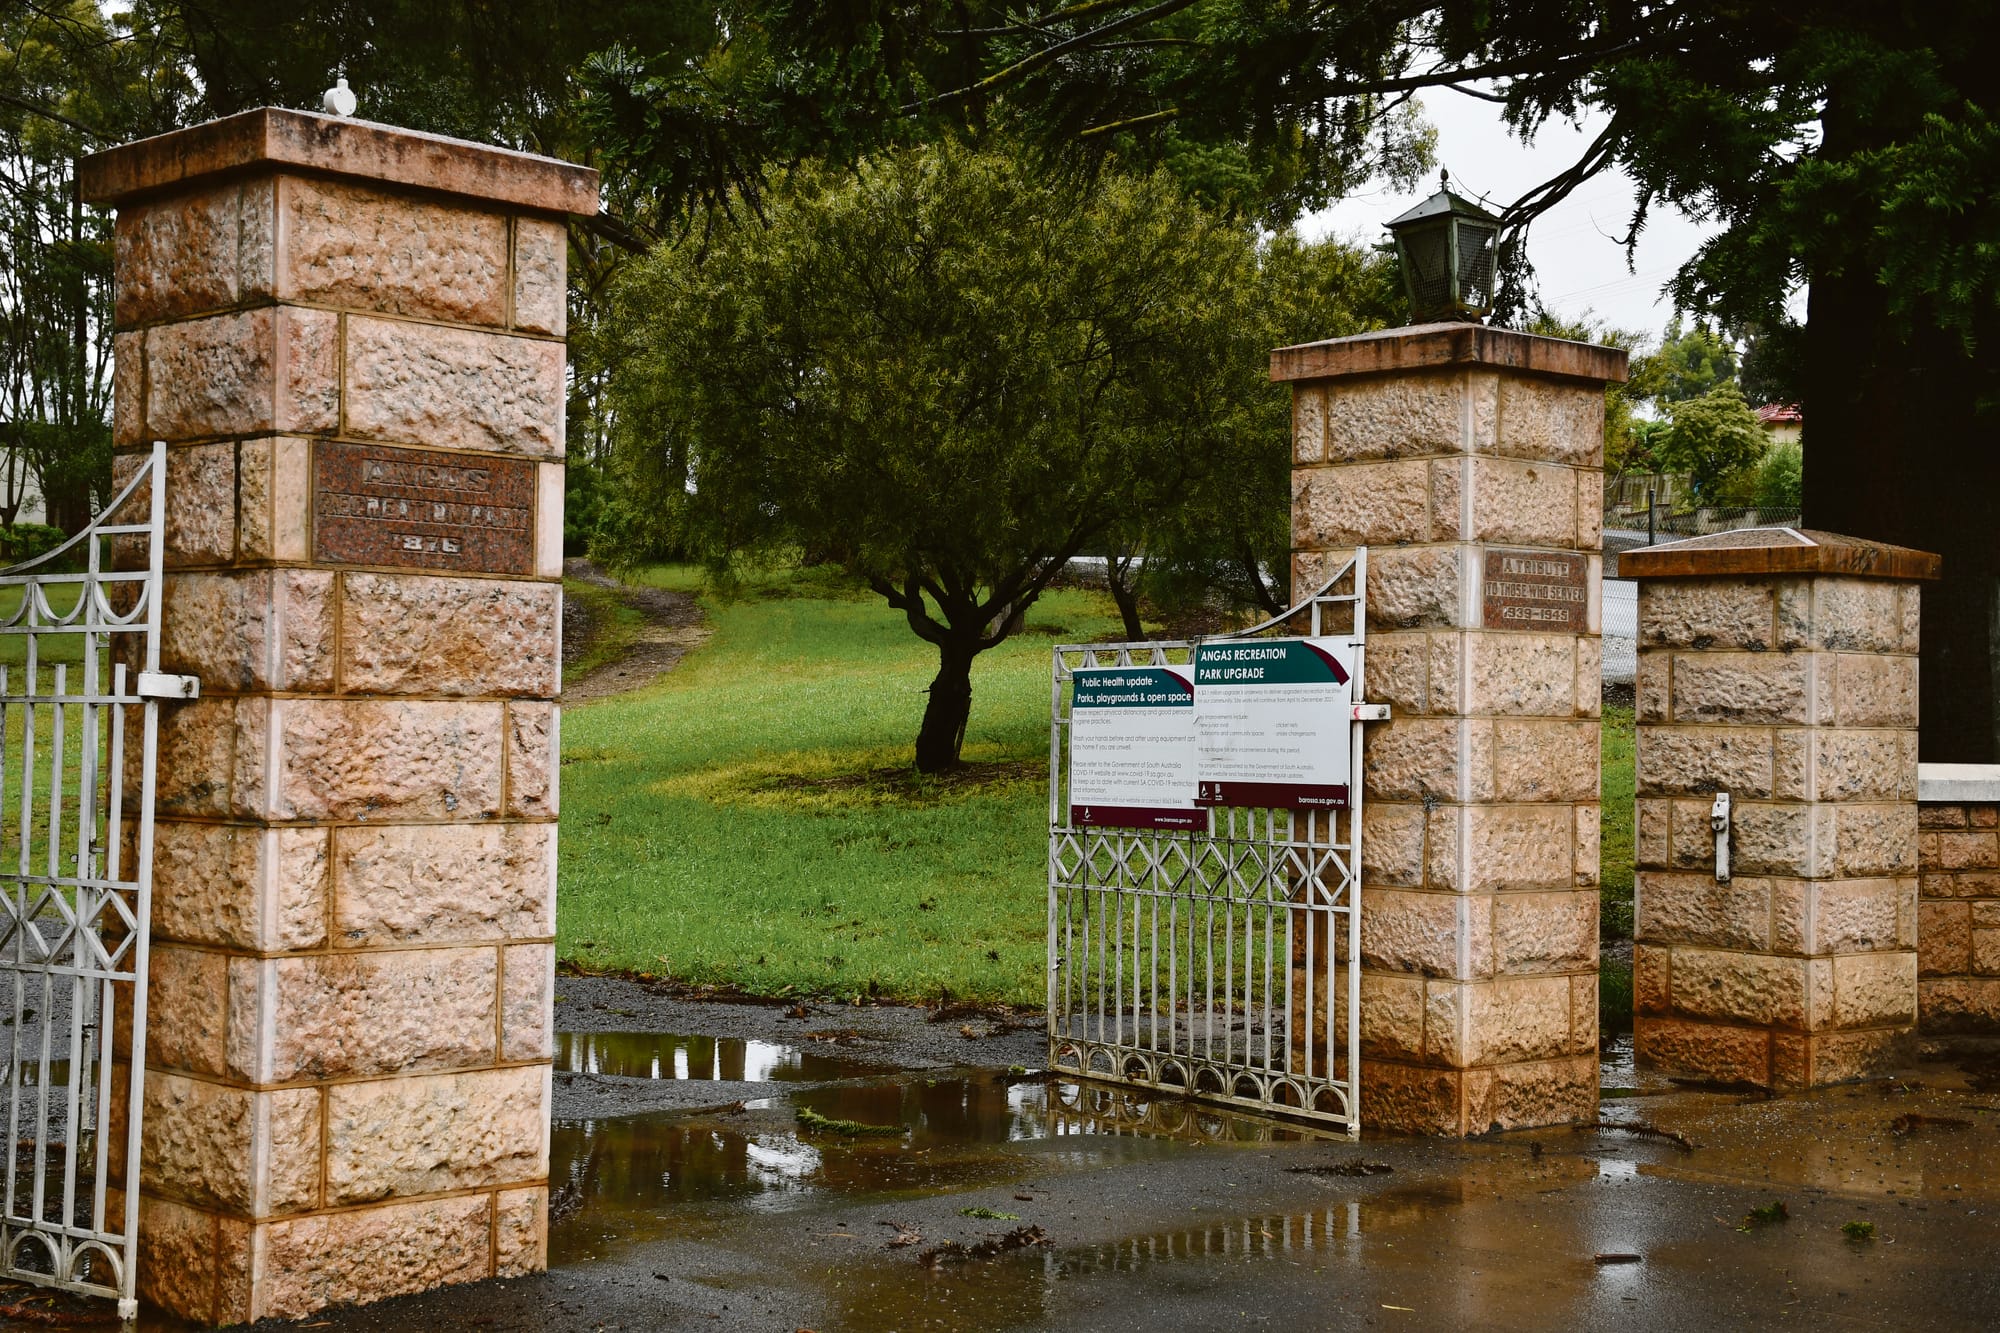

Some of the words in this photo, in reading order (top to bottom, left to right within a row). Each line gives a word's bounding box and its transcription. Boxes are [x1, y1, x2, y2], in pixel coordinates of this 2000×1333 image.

[364, 460, 489, 492] ANGAS
[319, 494, 462, 523] RECREATION
[471, 507, 528, 530] PARK
[1504, 559, 1512, 572] A
[1517, 560, 1568, 577] TRIBUTE
[1486, 582, 1498, 595] TO
[1500, 583, 1527, 597] THOSE
[1528, 585, 1549, 598] WHO
[1550, 586, 1584, 601] SERVED
[1504, 608, 1567, 620] 1939-1945
[1200, 649, 1232, 661] ANGAS
[1234, 648, 1286, 660] RECREATION
[1200, 668, 1221, 679] PARK
[1224, 668, 1264, 679] UPGRADE
[1082, 678, 1100, 687] Public
[1102, 677, 1125, 686] Health
[1126, 676, 1153, 688] update
[1077, 693, 1096, 704] Parks,
[1096, 693, 1138, 705] playgrounds
[1140, 693, 1145, 701] &
[1147, 693, 1166, 703] open
[1167, 693, 1192, 703] space
